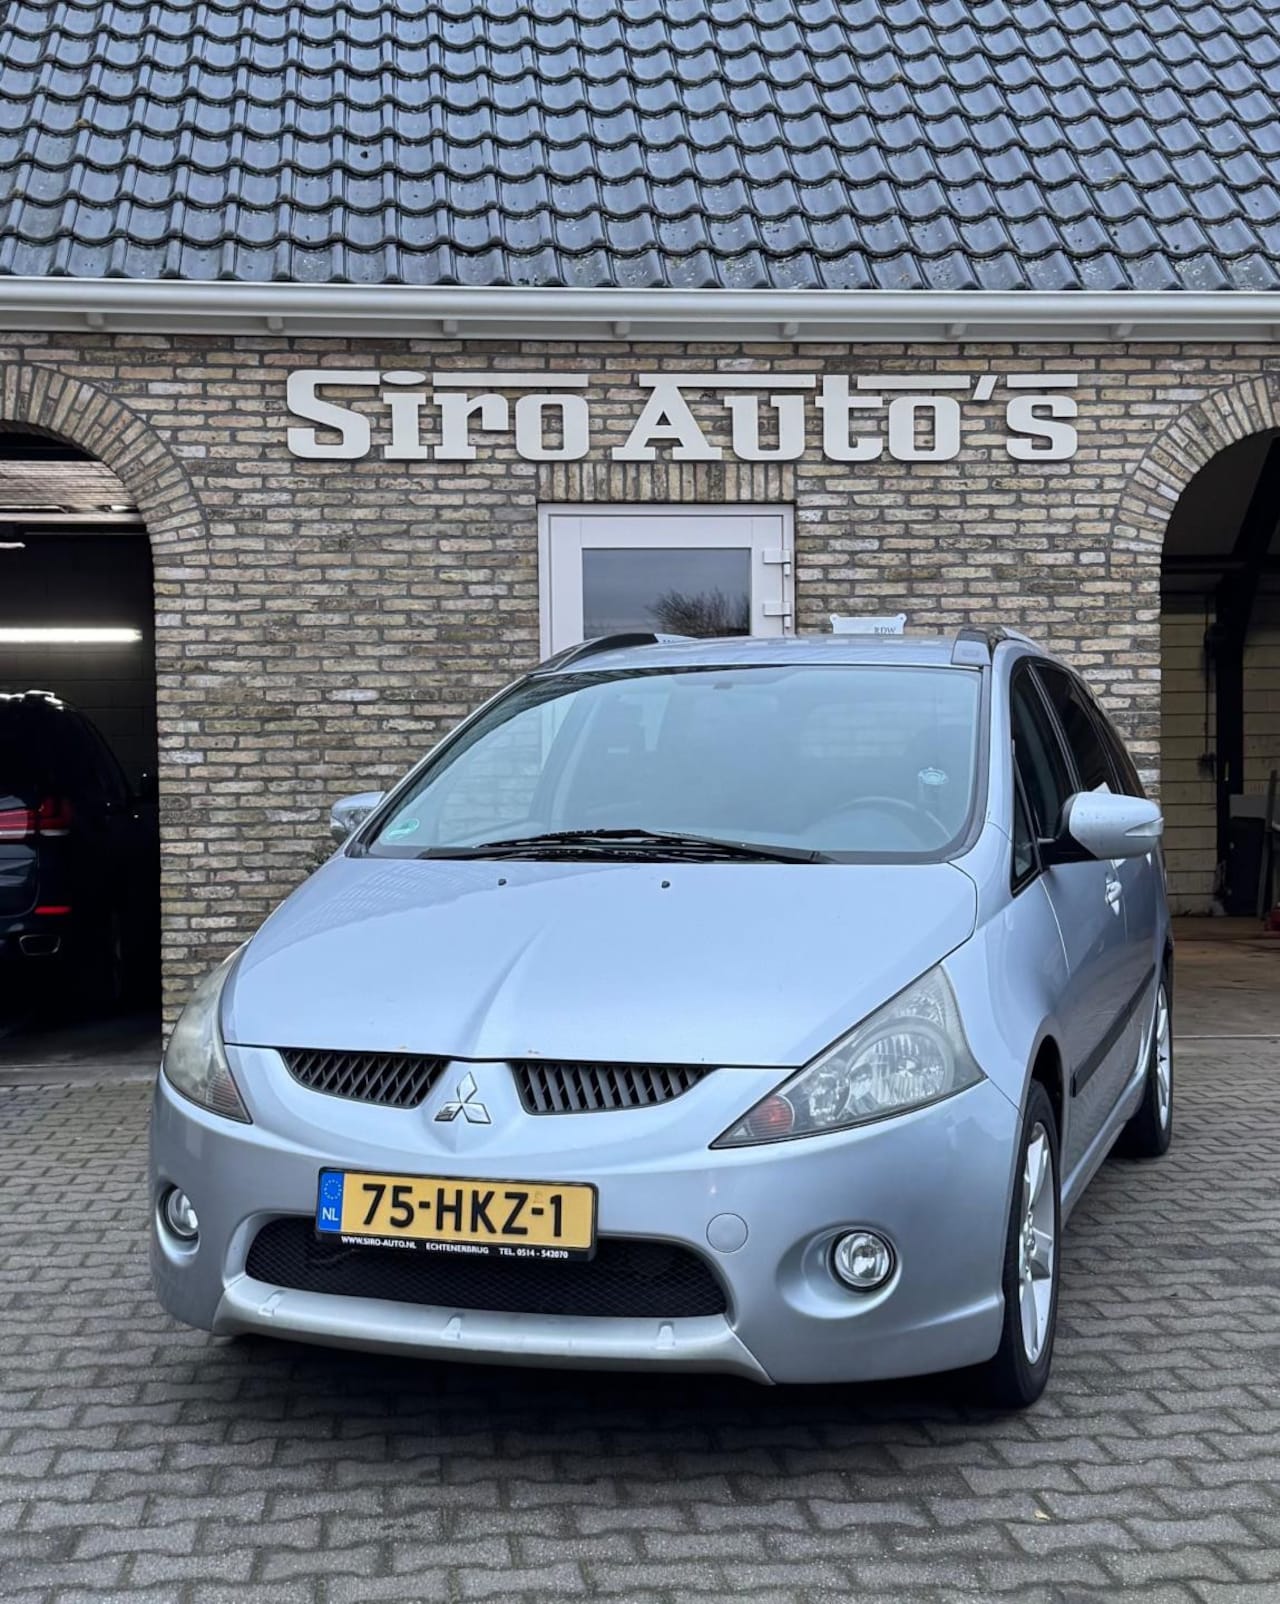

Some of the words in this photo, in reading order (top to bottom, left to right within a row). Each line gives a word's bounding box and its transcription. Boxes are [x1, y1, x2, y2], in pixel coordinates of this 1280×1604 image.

[287, 370, 589, 461] Siro
[612, 374, 1079, 462] Auto's
[322, 1207, 339, 1221] NL
[362, 1183, 562, 1237] 75-HKZ-1
[341, 1235, 417, 1249] WWW.SIRO-AUTO.NL
[426, 1242, 489, 1254] ECHTENERBRUG
[499, 1248, 516, 1256] TEL.
[517, 1248, 535, 1257] 0514
